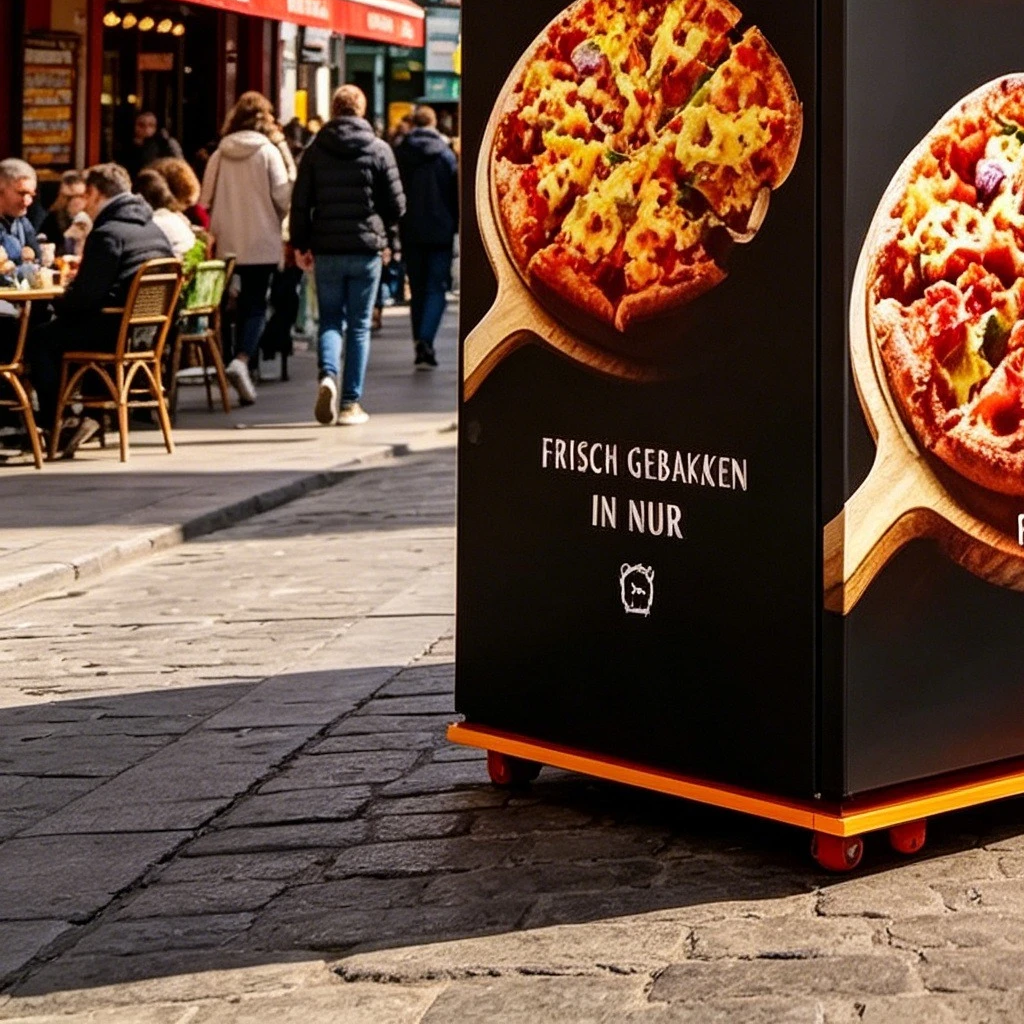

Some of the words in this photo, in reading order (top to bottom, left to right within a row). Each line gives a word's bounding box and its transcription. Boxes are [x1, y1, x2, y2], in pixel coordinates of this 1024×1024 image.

[541, 437, 618, 476] FRISCH
[627, 446, 748, 491] GEBAKKEN
[592, 494, 617, 529] IN
[628, 499, 684, 539] NUR
